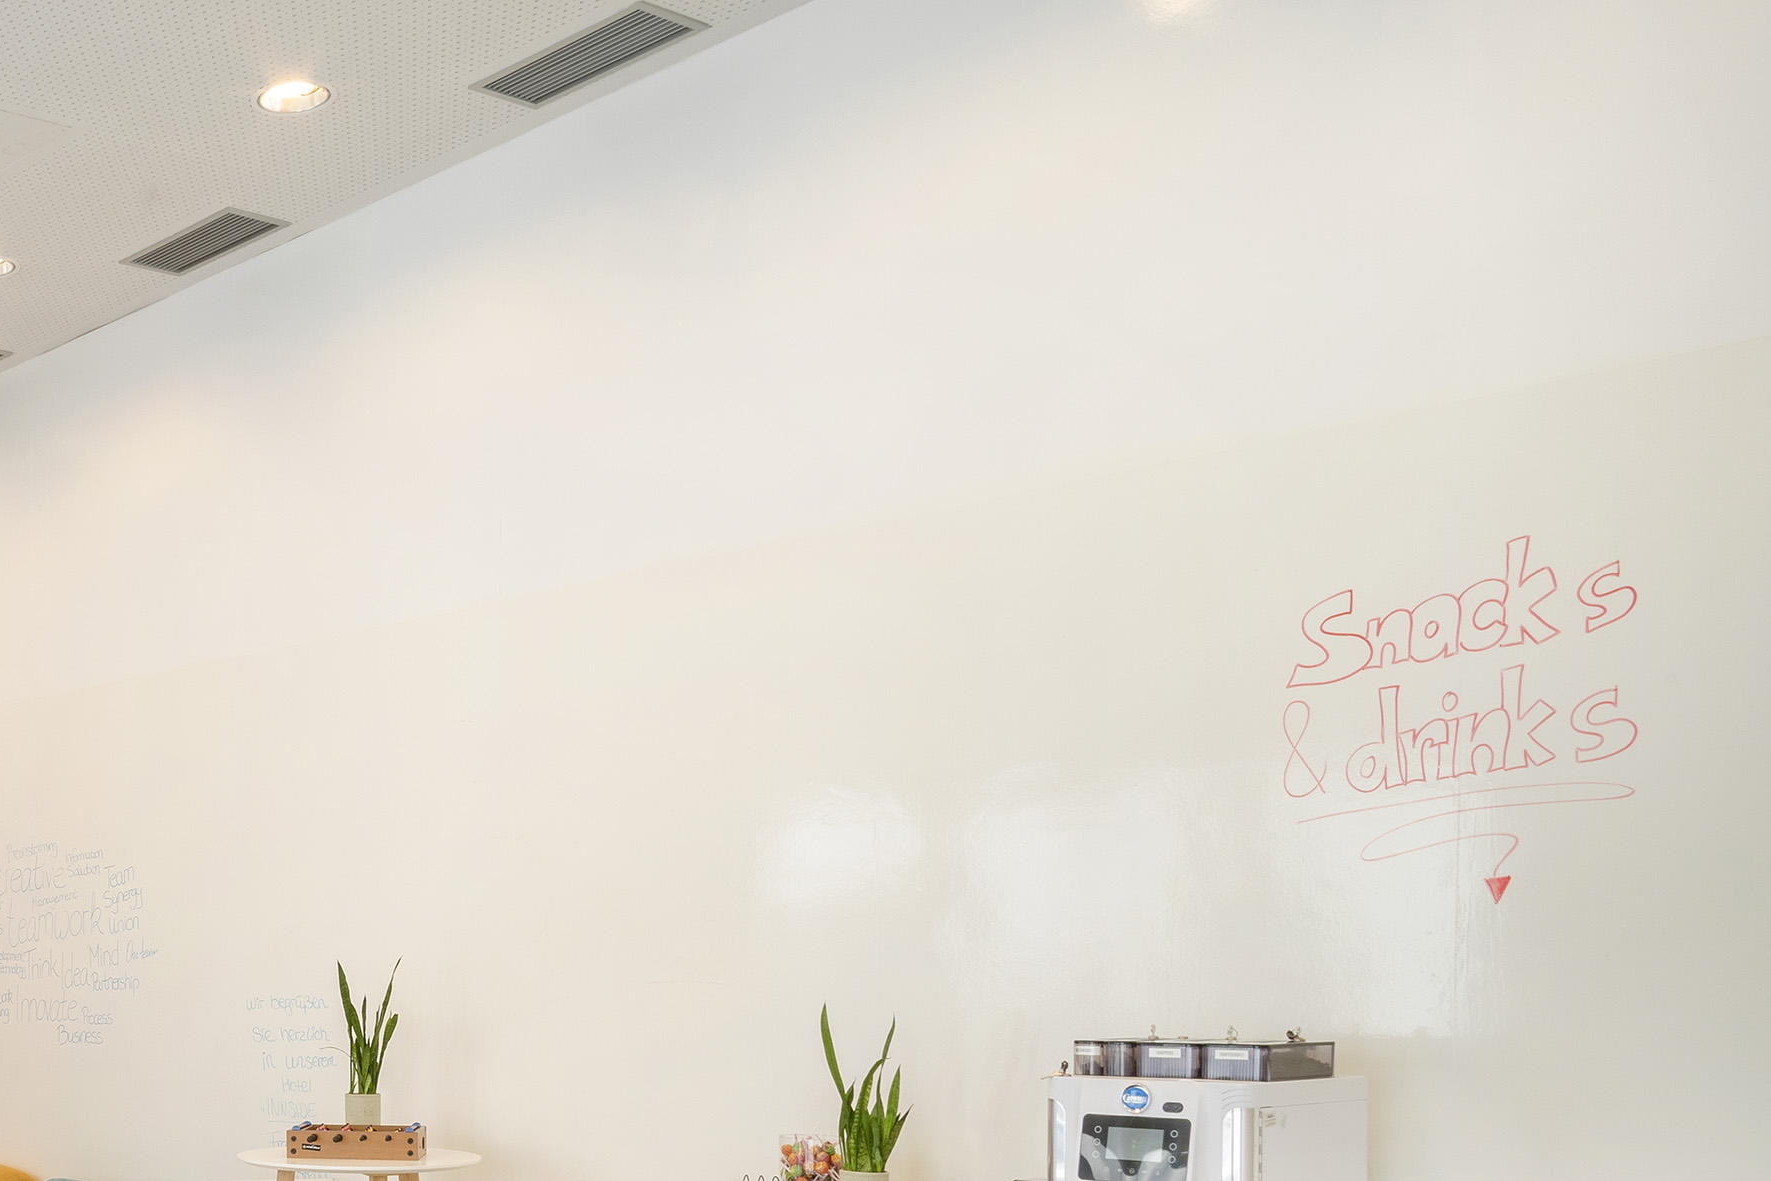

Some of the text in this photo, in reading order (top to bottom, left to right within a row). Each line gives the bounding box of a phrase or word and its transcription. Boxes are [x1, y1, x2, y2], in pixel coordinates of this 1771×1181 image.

[1285, 533, 1638, 690] Snacks
[1281, 663, 1639, 799] & drinks
[103, 864, 135, 889] Team
[103, 887, 144, 914] Synergy
[24, 947, 60, 980] Think
[89, 938, 119, 968] Mind
[61, 951, 91, 989] Idea
[81, 1005, 113, 1025] Process
[269, 994, 329, 1016] begrüßen
[252, 1026, 331, 1043] Sie herzlich
[280, 1075, 312, 1093] Hotel
